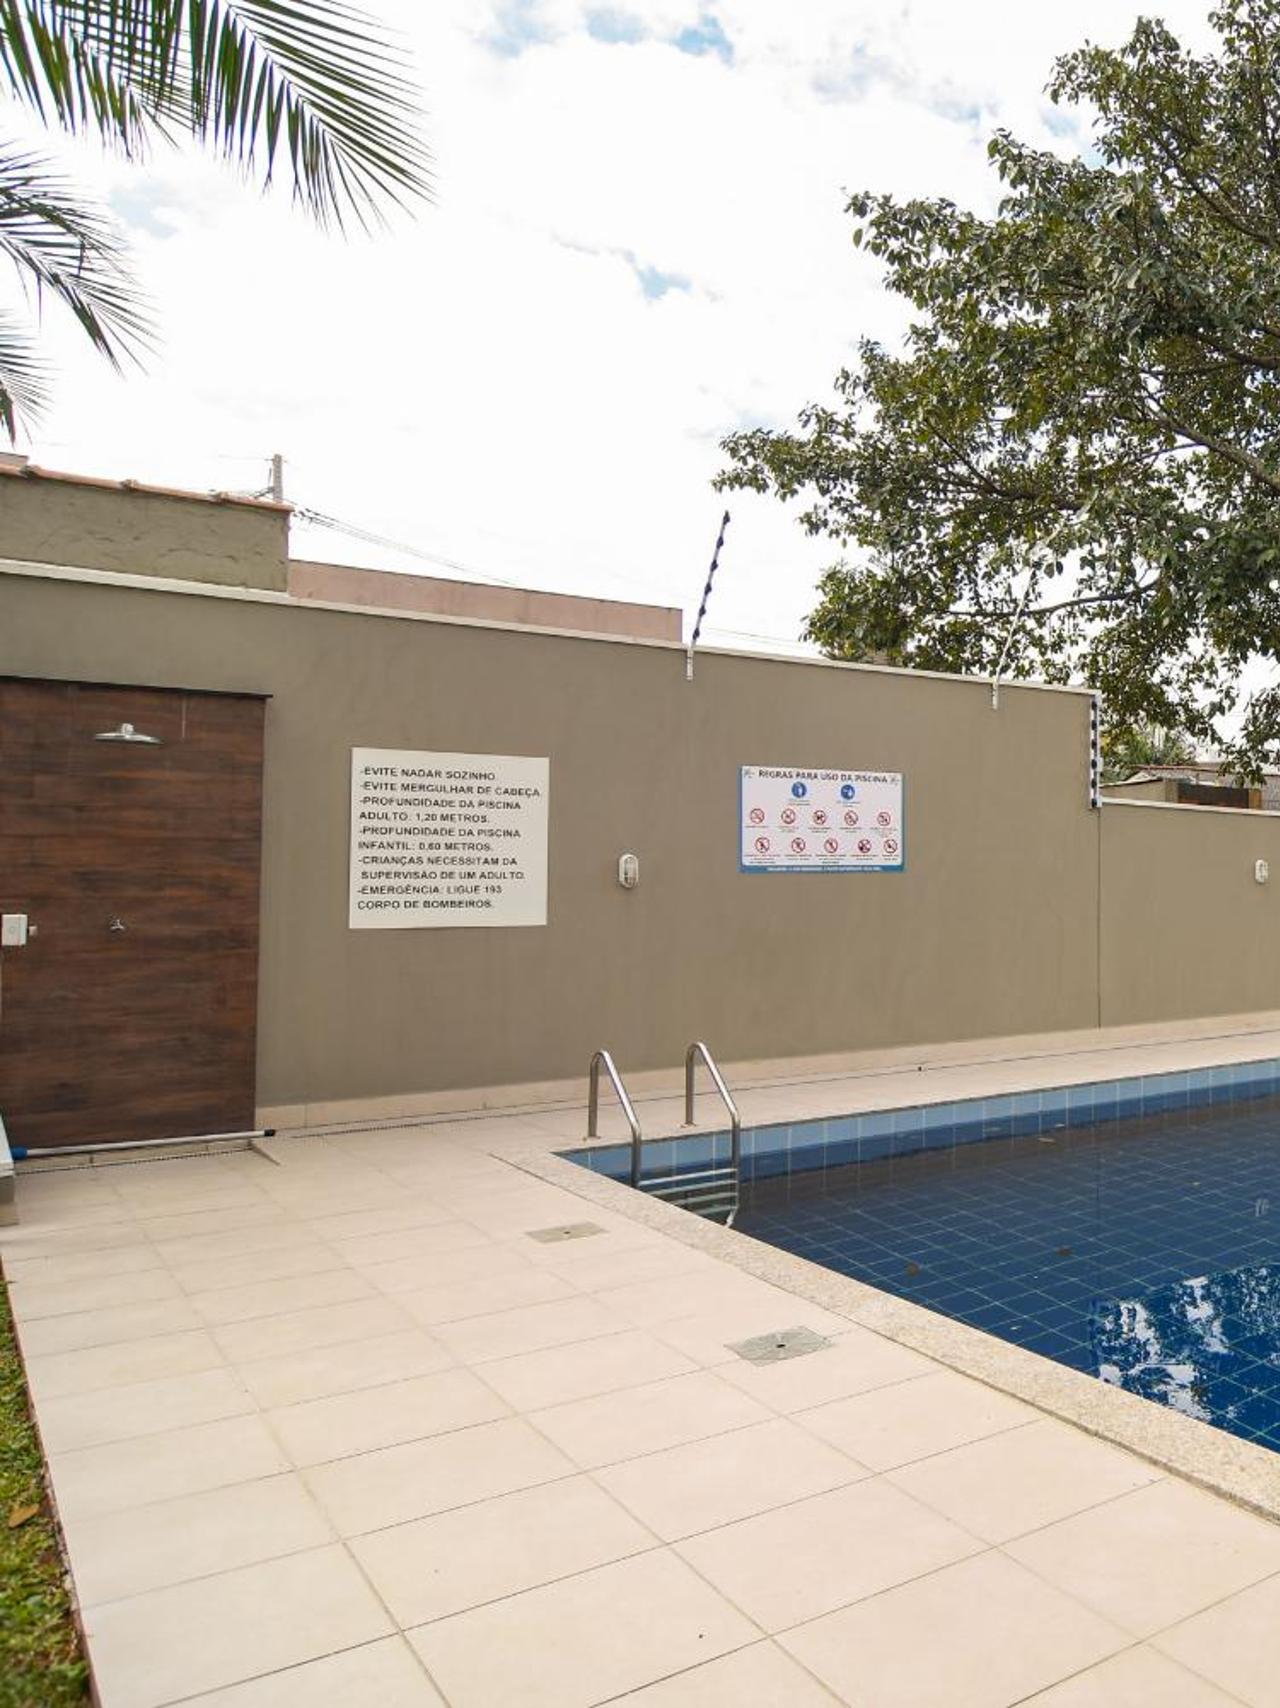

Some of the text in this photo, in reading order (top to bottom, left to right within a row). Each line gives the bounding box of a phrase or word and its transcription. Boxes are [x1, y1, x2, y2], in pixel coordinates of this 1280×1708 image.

[401, 768, 442, 778] NADAR
[759, 770, 887, 783] REGRAS PARA USO DA PISCINA
[401, 783, 473, 794] MERGULHAR
[360, 797, 521, 810] -PROFUNDIDADE DA PISCINA
[359, 827, 454, 836] -PROFUNDIDADE
[358, 856, 424, 867] -CRIANÇAS
[428, 857, 498, 865] NECESSITAM
[361, 870, 437, 880] SUPERVISÃO
[440, 871, 455, 879] DE
[459, 871, 475, 879] UM
[447, 886, 480, 894] LIGUE
[484, 885, 502, 893] 193
[358, 900, 400, 910] CORPO
[404, 901, 420, 909] DE
